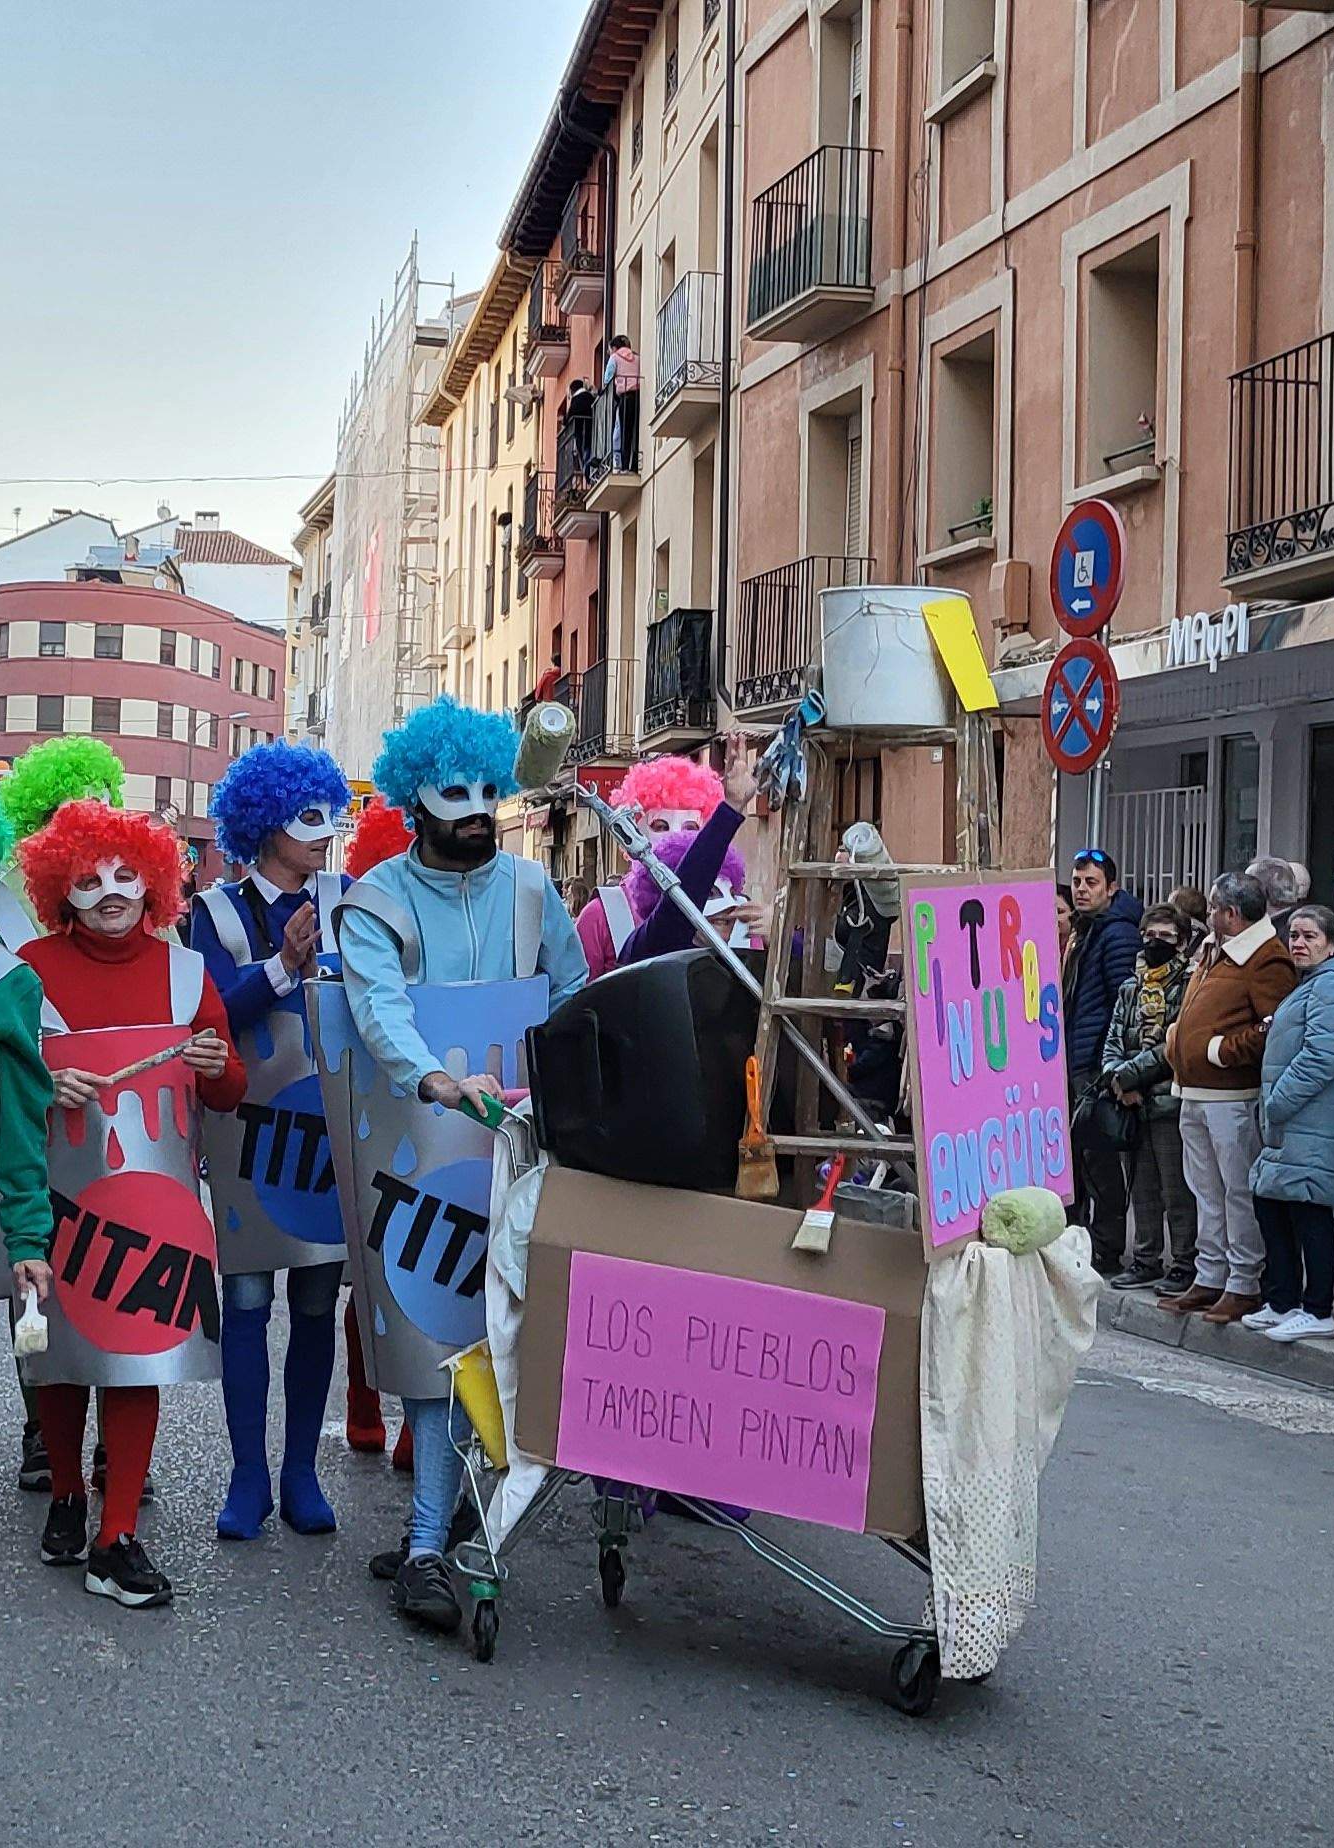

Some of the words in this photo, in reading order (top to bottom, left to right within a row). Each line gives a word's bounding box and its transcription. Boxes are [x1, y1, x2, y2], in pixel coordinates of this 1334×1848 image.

[586, 1294, 653, 1358] LOS
[685, 1316, 857, 1397] PUEBLOS
[583, 1377, 713, 1449] TAMBIEN
[739, 1407, 856, 1478] PINTAN
